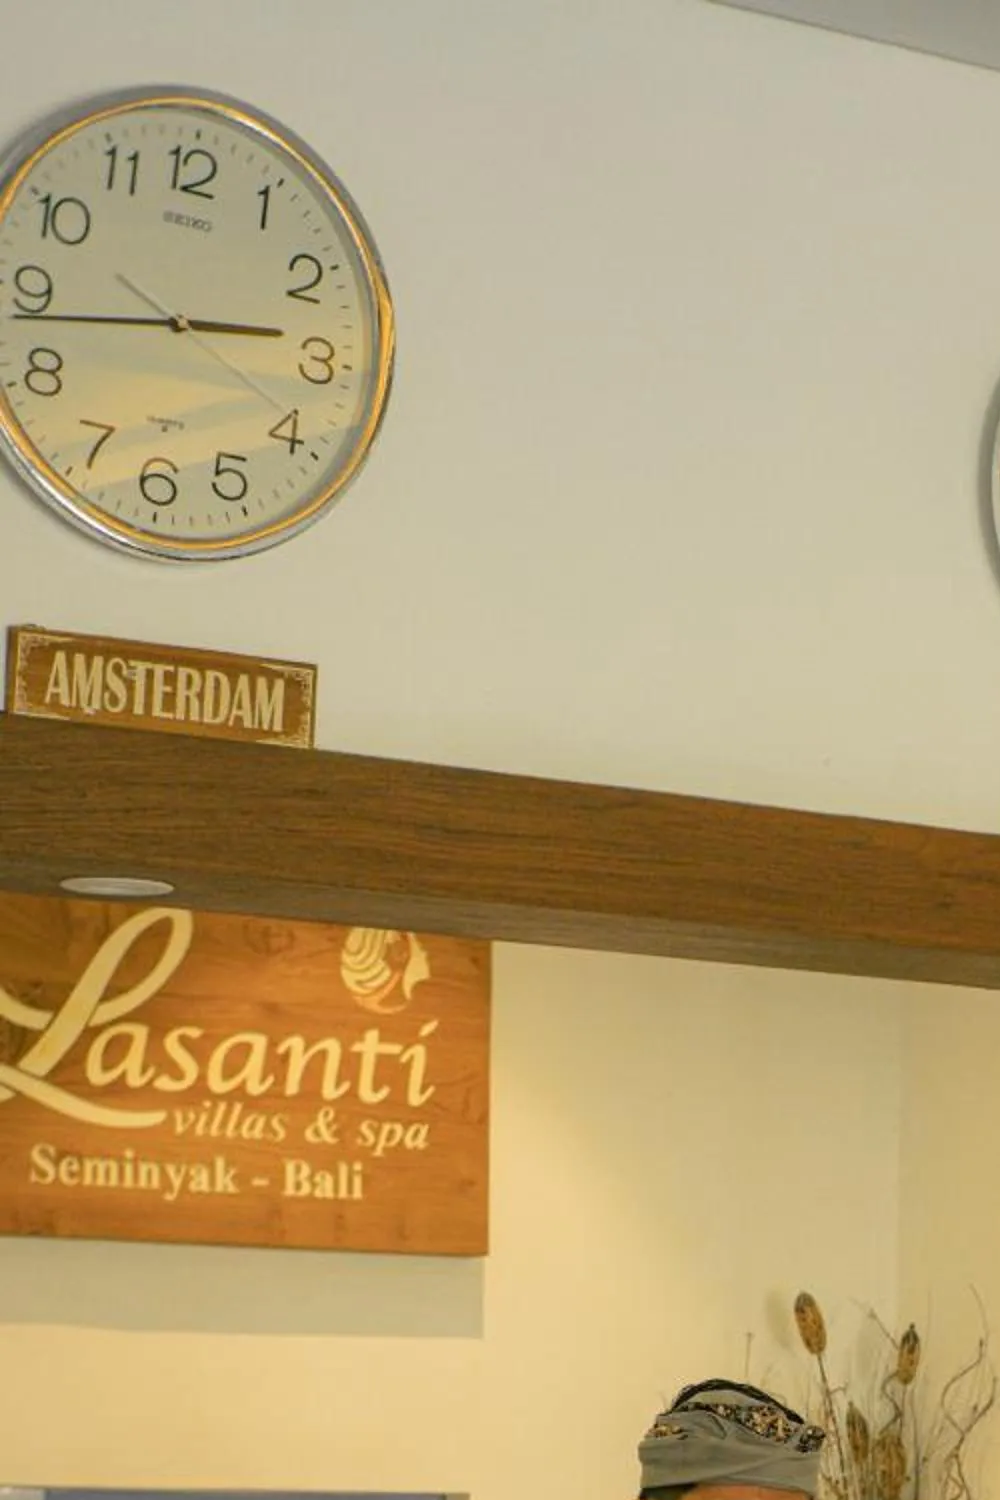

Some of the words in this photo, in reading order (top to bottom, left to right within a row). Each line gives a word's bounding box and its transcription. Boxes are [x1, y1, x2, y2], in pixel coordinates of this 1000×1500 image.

[105, 145, 140, 196] 11
[168, 145, 217, 200] 12
[37, 193, 91, 245] 10
[257, 185, 271, 230] 1
[13, 265, 53, 313] 9
[286, 254, 324, 304] 2
[24, 347, 63, 396] 8
[299, 337, 336, 385] 3
[80, 419, 116, 469] 7
[268, 409, 304, 455] 4
[139, 457, 178, 506] 6
[211, 452, 248, 501] 5
[44, 649, 287, 732] AMSTERDAM
[172, 1100, 288, 1142] villas
[304, 1106, 341, 1145] &
[357, 1117, 431, 1157] spa
[29, 1142, 240, 1200] Seminyak
[283, 1158, 364, 1201] Bali
